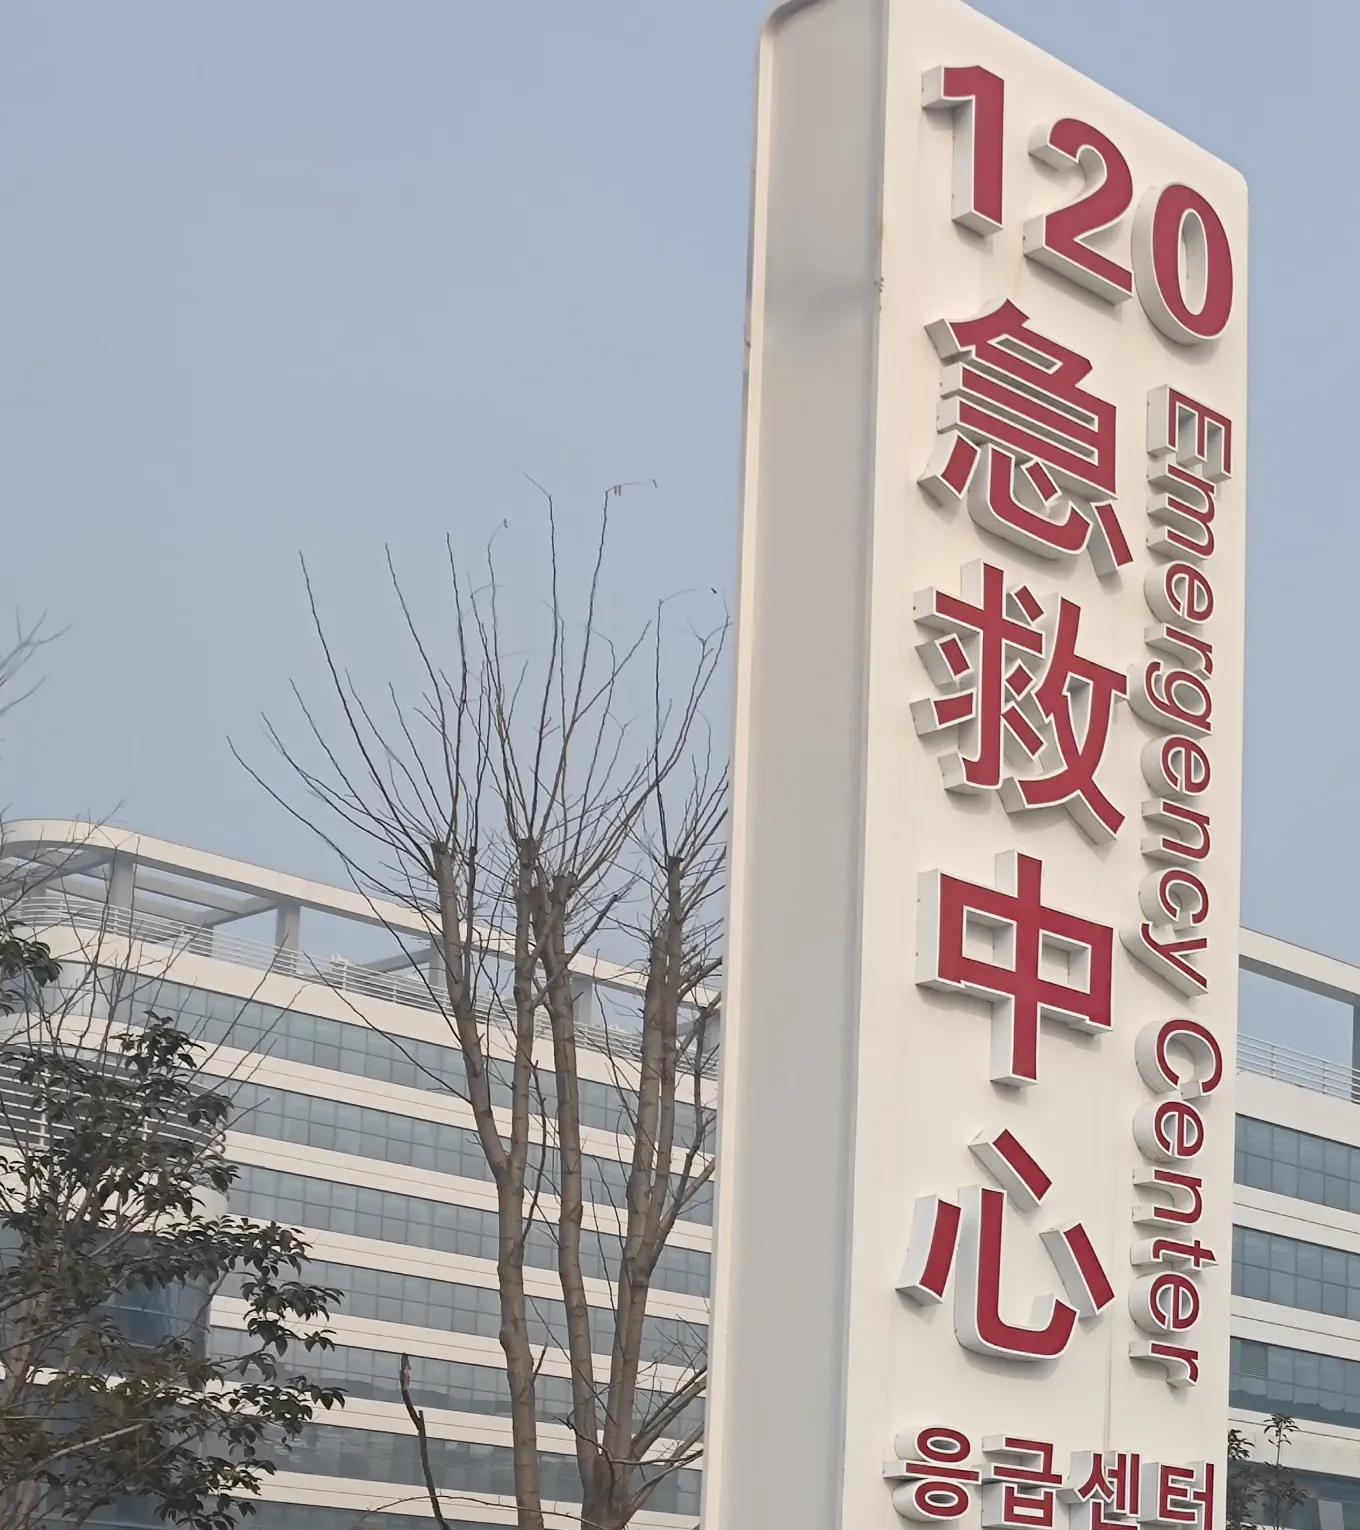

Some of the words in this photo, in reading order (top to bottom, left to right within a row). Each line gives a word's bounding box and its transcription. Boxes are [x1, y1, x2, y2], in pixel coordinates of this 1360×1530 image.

[924, 65, 1234, 345] 120
[896, 298, 1136, 1360] 急救中心
[1126, 384, 1233, 997] Emergency
[1129, 1016, 1223, 1389] Center
